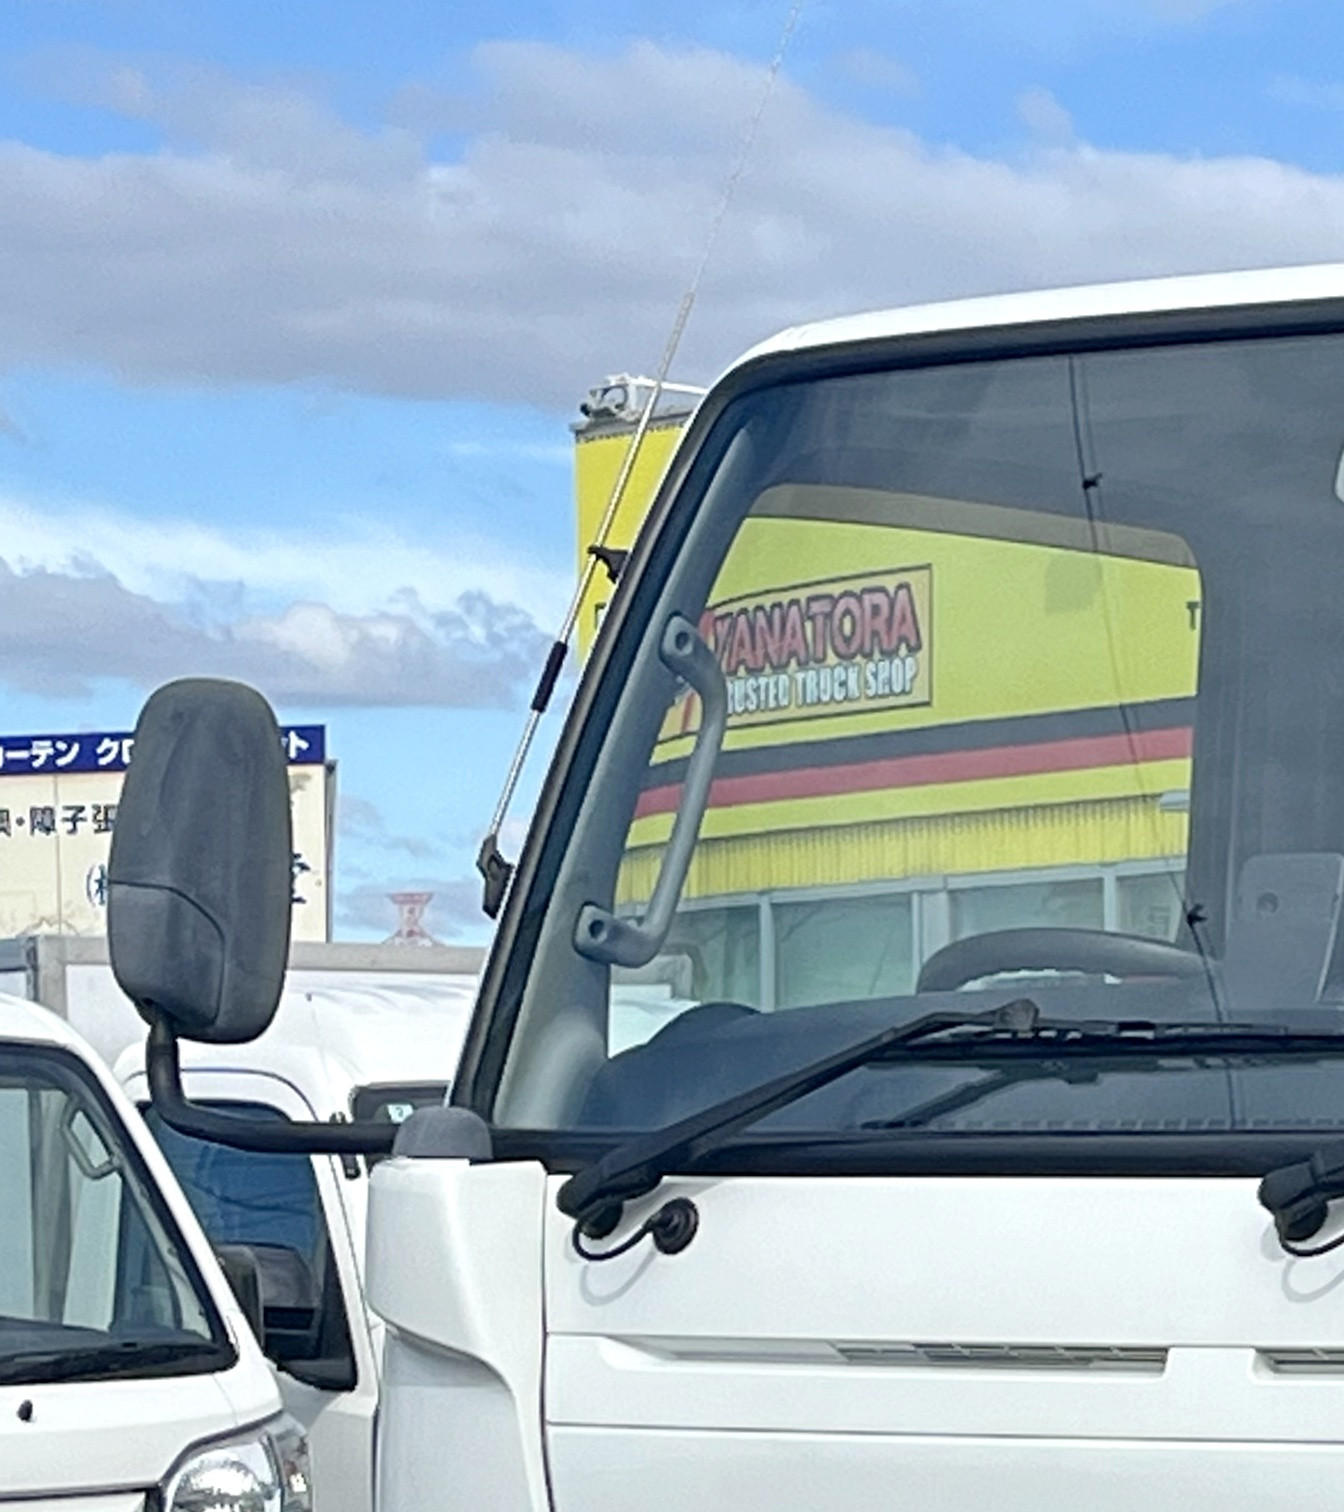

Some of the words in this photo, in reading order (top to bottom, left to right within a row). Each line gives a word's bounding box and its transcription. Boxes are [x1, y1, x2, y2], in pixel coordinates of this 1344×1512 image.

[727, 674, 790, 715] USTED
[796, 664, 860, 707] TRUCK
[865, 657, 918, 698] SHOP
[0, 739, 80, 769] ーテン
